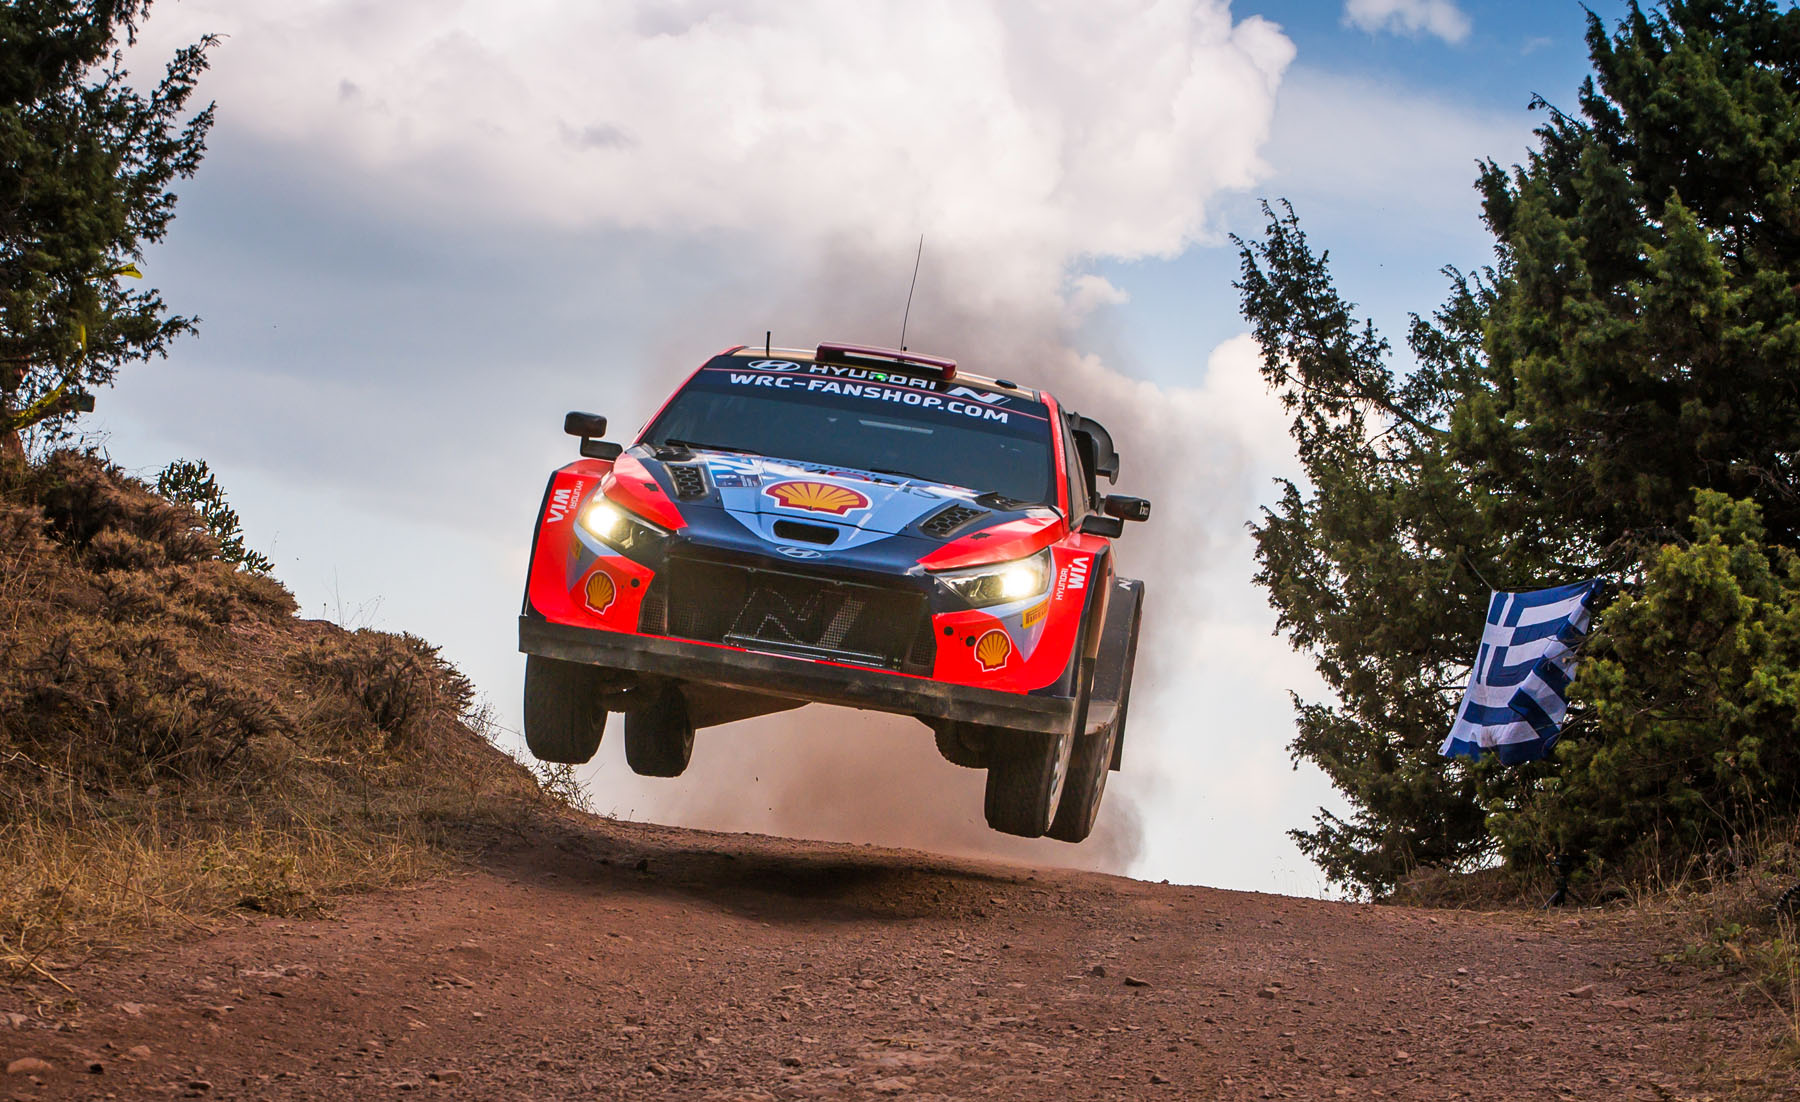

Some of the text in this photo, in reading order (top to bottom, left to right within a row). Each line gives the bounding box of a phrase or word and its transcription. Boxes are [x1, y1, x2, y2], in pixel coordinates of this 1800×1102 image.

[809, 364, 937, 390] HYUNDAI
[730, 373, 1009, 424] WRC-FANSHOP.COM
[569, 481, 584, 509] HYUNDAI
[1055, 568, 1068, 601] HYUNDAI
